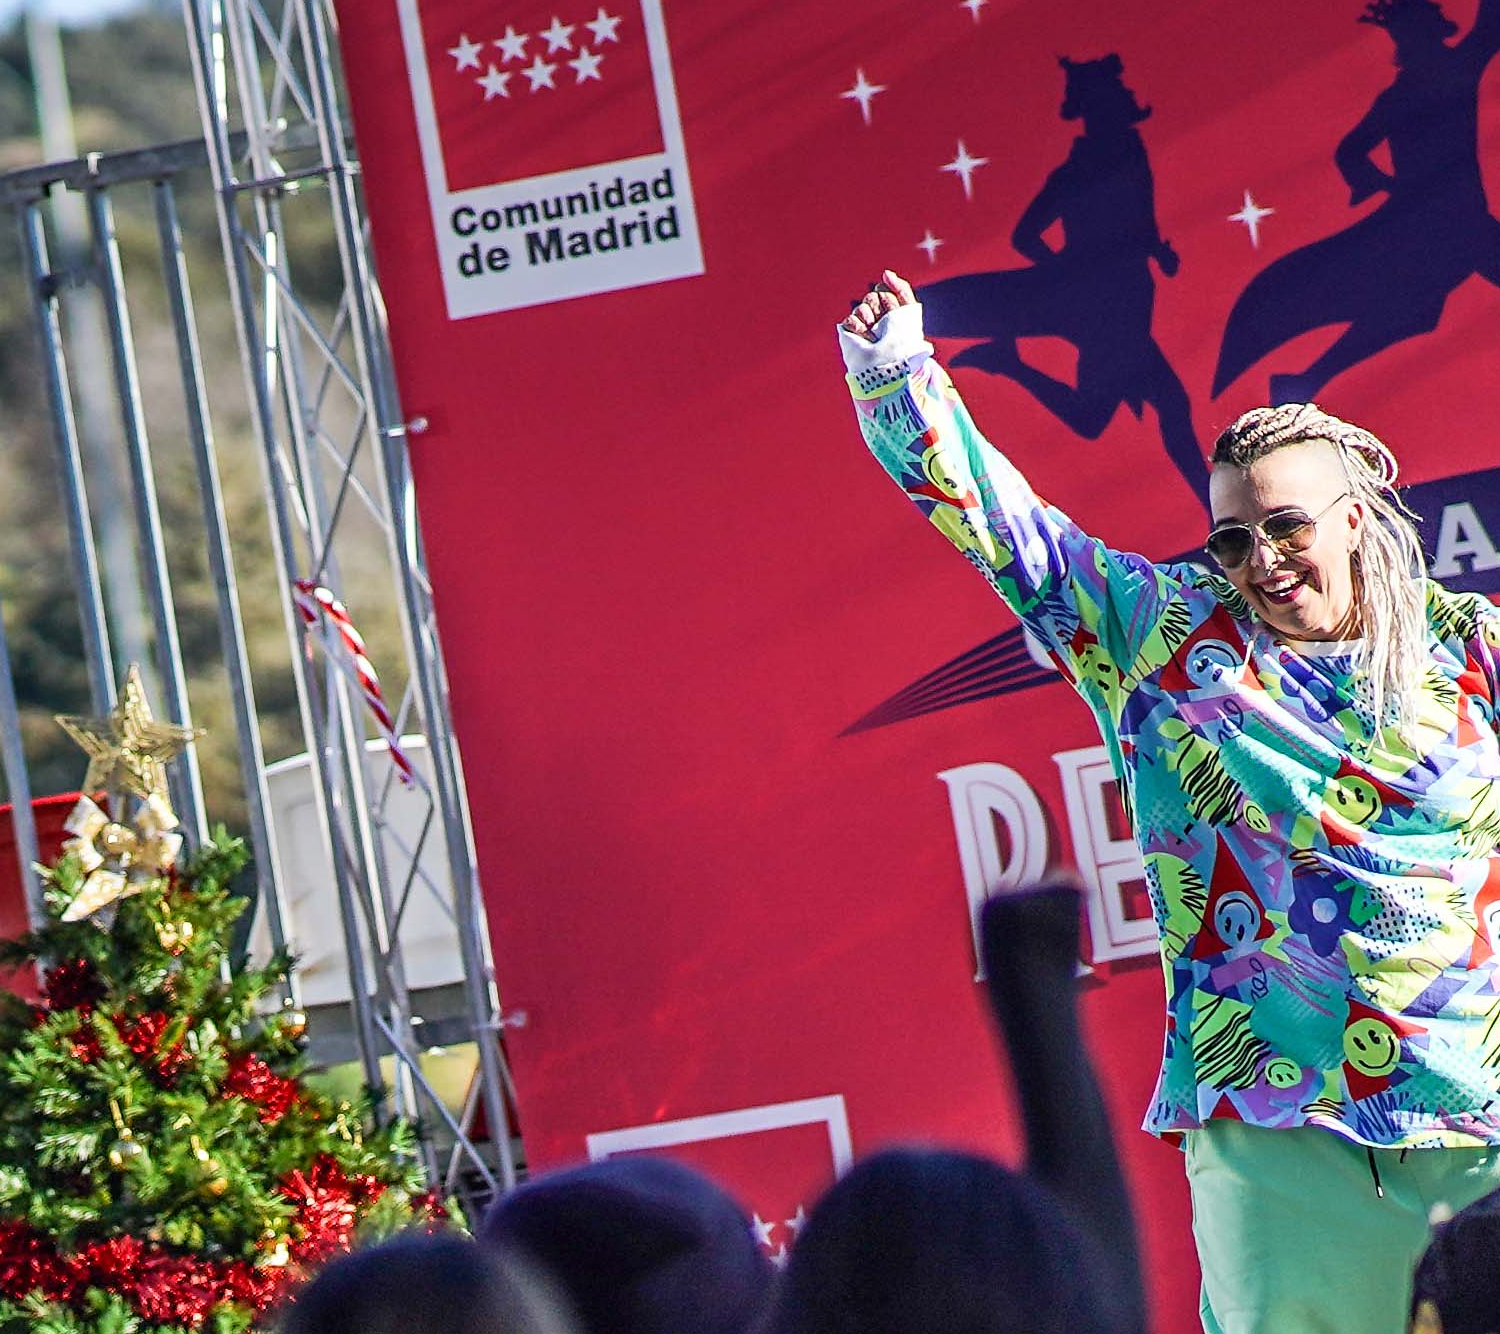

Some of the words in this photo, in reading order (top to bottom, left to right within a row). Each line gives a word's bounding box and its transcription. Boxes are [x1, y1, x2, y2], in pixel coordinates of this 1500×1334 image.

[451, 168, 675, 236] Comunidad
[457, 244, 510, 278] de
[525, 206, 681, 267] Madrid
